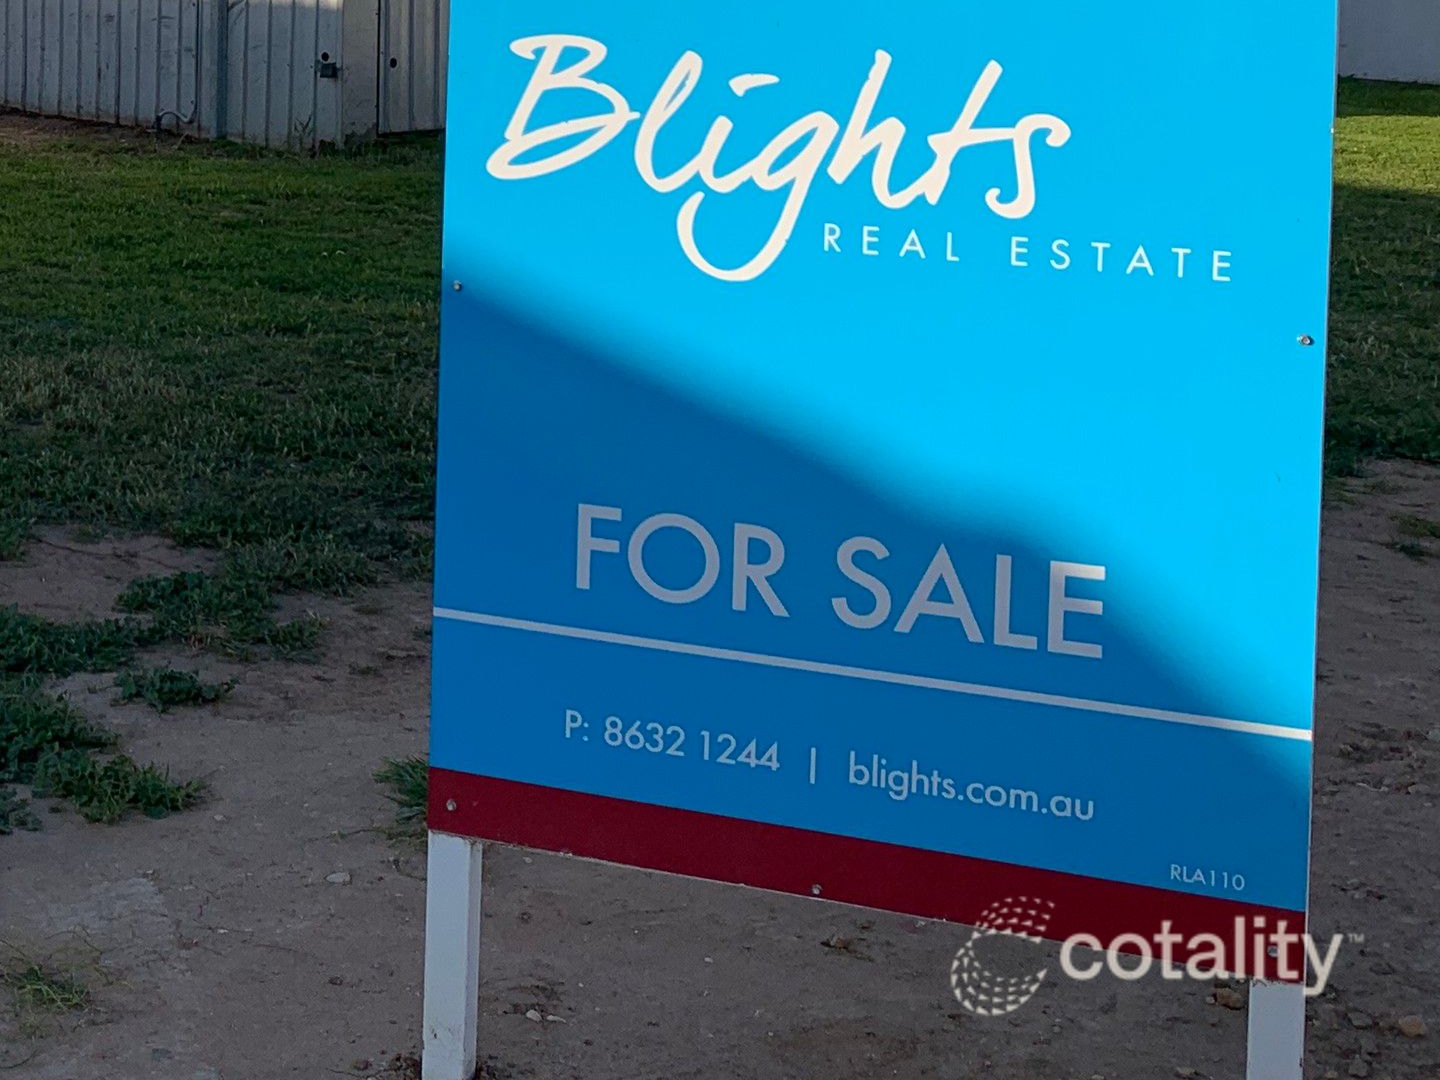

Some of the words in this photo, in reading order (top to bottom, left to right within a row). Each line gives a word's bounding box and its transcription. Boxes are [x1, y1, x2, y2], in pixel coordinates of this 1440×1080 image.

[485, 33, 1071, 282] Blights
[823, 222, 961, 264] REAL
[1010, 237, 1234, 282] ESTATE
[576, 503, 790, 617] FOR
[831, 536, 1107, 659] SALE
[564, 709, 590, 741] P:
[604, 716, 685, 758] 8632
[700, 730, 781, 772] 1244
[848, 750, 1095, 821] blights.com.au
[1170, 864, 1246, 891] RLA110
